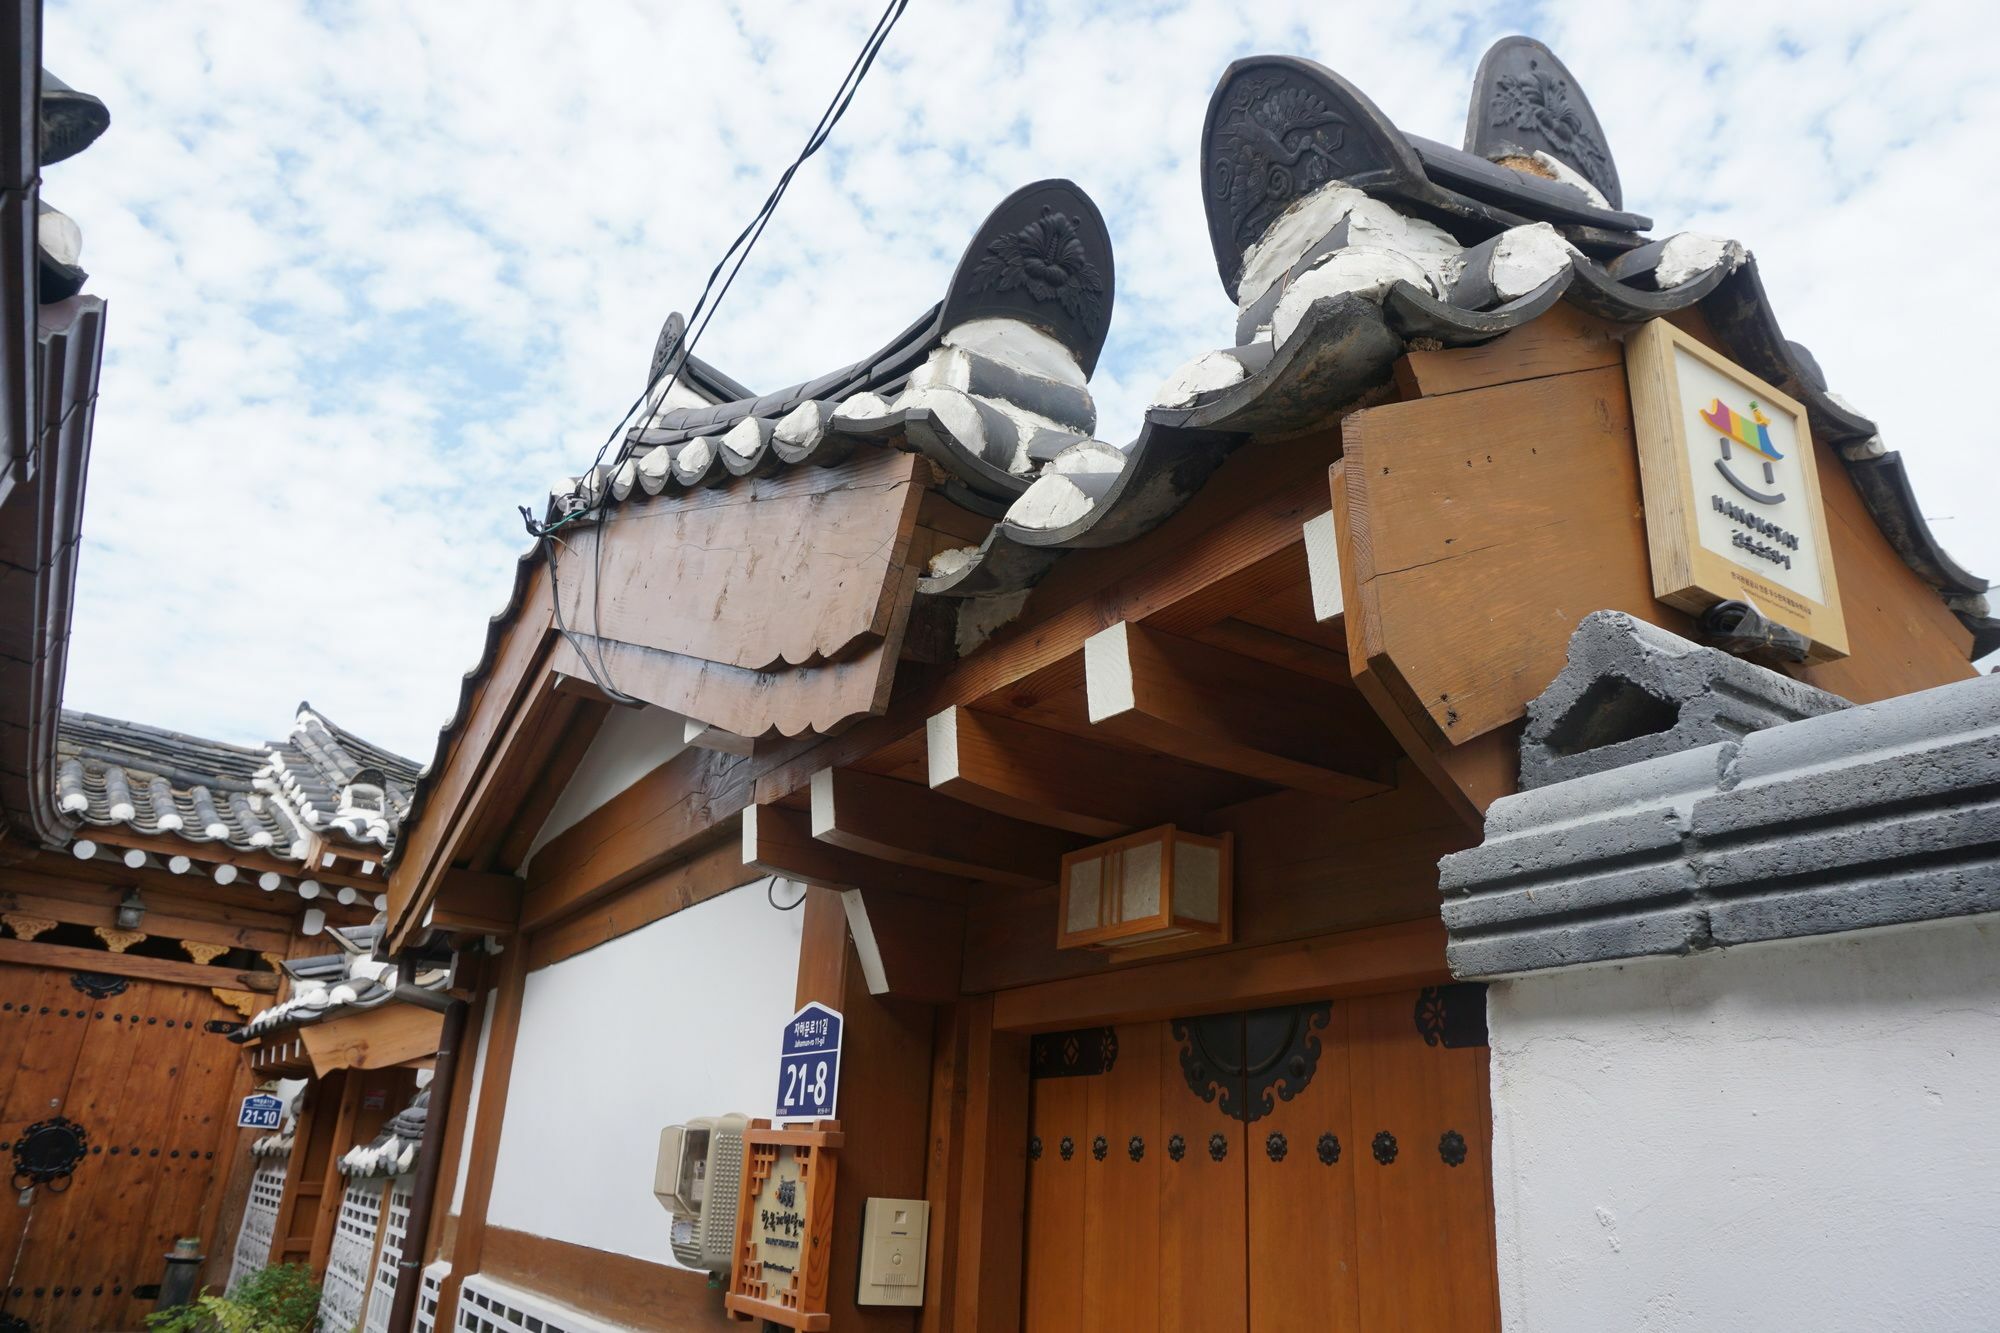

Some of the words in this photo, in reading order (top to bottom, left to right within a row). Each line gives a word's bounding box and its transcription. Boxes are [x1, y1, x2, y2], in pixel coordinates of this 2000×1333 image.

[1711, 494, 1799, 551] HANOKSTAY
[794, 1018, 829, 1037] 자하문로11길
[784, 1061, 827, 1106] 21-8
[243, 1110, 277, 1124] 21-10
